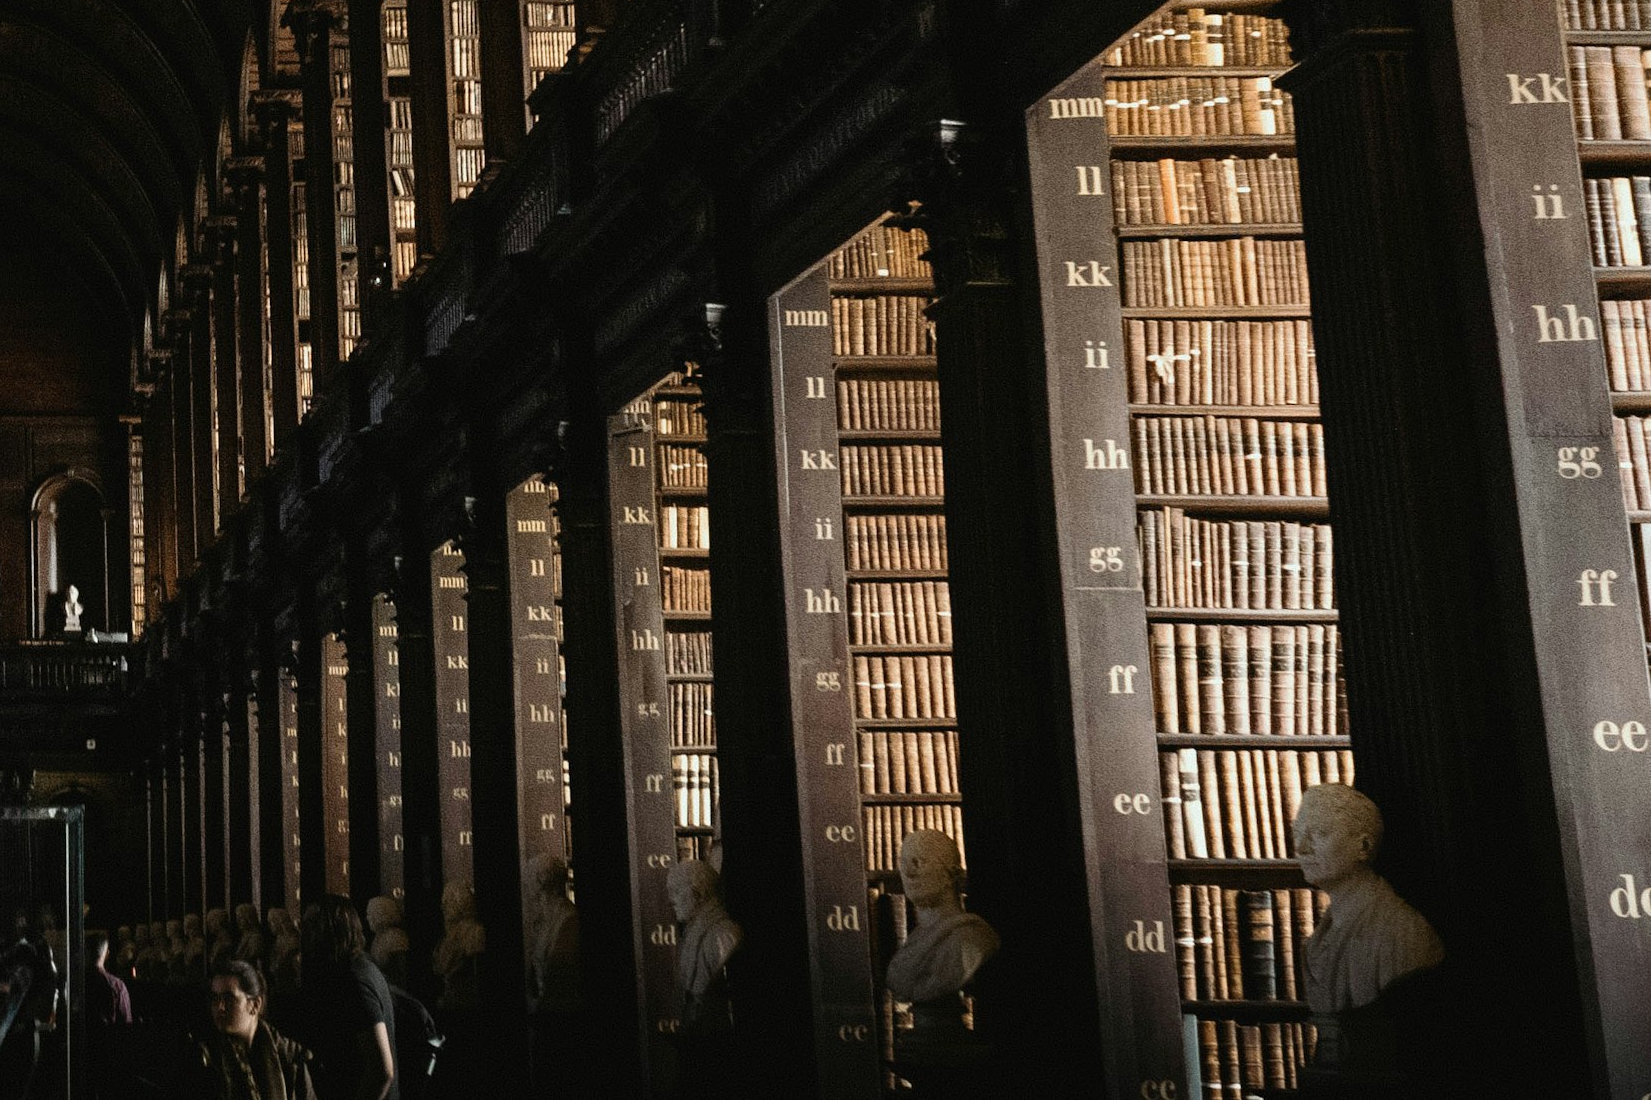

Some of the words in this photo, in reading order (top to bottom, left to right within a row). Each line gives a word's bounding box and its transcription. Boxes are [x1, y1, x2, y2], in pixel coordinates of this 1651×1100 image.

[1507, 73, 1567, 104] kk
[1050, 98, 1103, 118] mm
[1077, 166, 1104, 195] ll
[1532, 185, 1566, 219] ii
[1066, 261, 1112, 286] kk
[786, 311, 828, 326] mm
[1533, 304, 1597, 342] hh
[1086, 341, 1109, 369] ii
[807, 377, 825, 398] ll
[630, 447, 645, 466] ll
[802, 450, 836, 469] kk
[1084, 439, 1129, 469] hh
[1558, 447, 1601, 478] gg
[624, 507, 652, 524] kk
[518, 521, 546, 532] mm
[816, 518, 833, 539] ii
[531, 560, 544, 576] ll
[1090, 547, 1123, 572] gg
[636, 568, 649, 585] ii
[1578, 569, 1617, 606] ff
[805, 589, 840, 613] hh
[528, 606, 552, 621] kk
[453, 616, 464, 631] ll
[633, 629, 660, 651] hh
[448, 656, 467, 668] kk
[537, 659, 548, 673] ii
[816, 672, 840, 690] gg
[1109, 665, 1137, 693] ff
[530, 705, 554, 722] hh
[638, 703, 660, 717] gg
[1594, 721, 1648, 751] ee
[827, 744, 845, 765] ff
[537, 769, 555, 782] gg
[646, 774, 663, 793] ff
[1114, 793, 1151, 815] ee
[542, 814, 555, 829] ff
[826, 826, 854, 842] ee
[648, 855, 671, 867] ee
[827, 906, 859, 931] dd
[651, 925, 676, 945] dd
[1126, 920, 1166, 952] dd
[658, 1019, 680, 1032] cc
[839, 1026, 867, 1040] cc
[1142, 1081, 1175, 1100] cc
